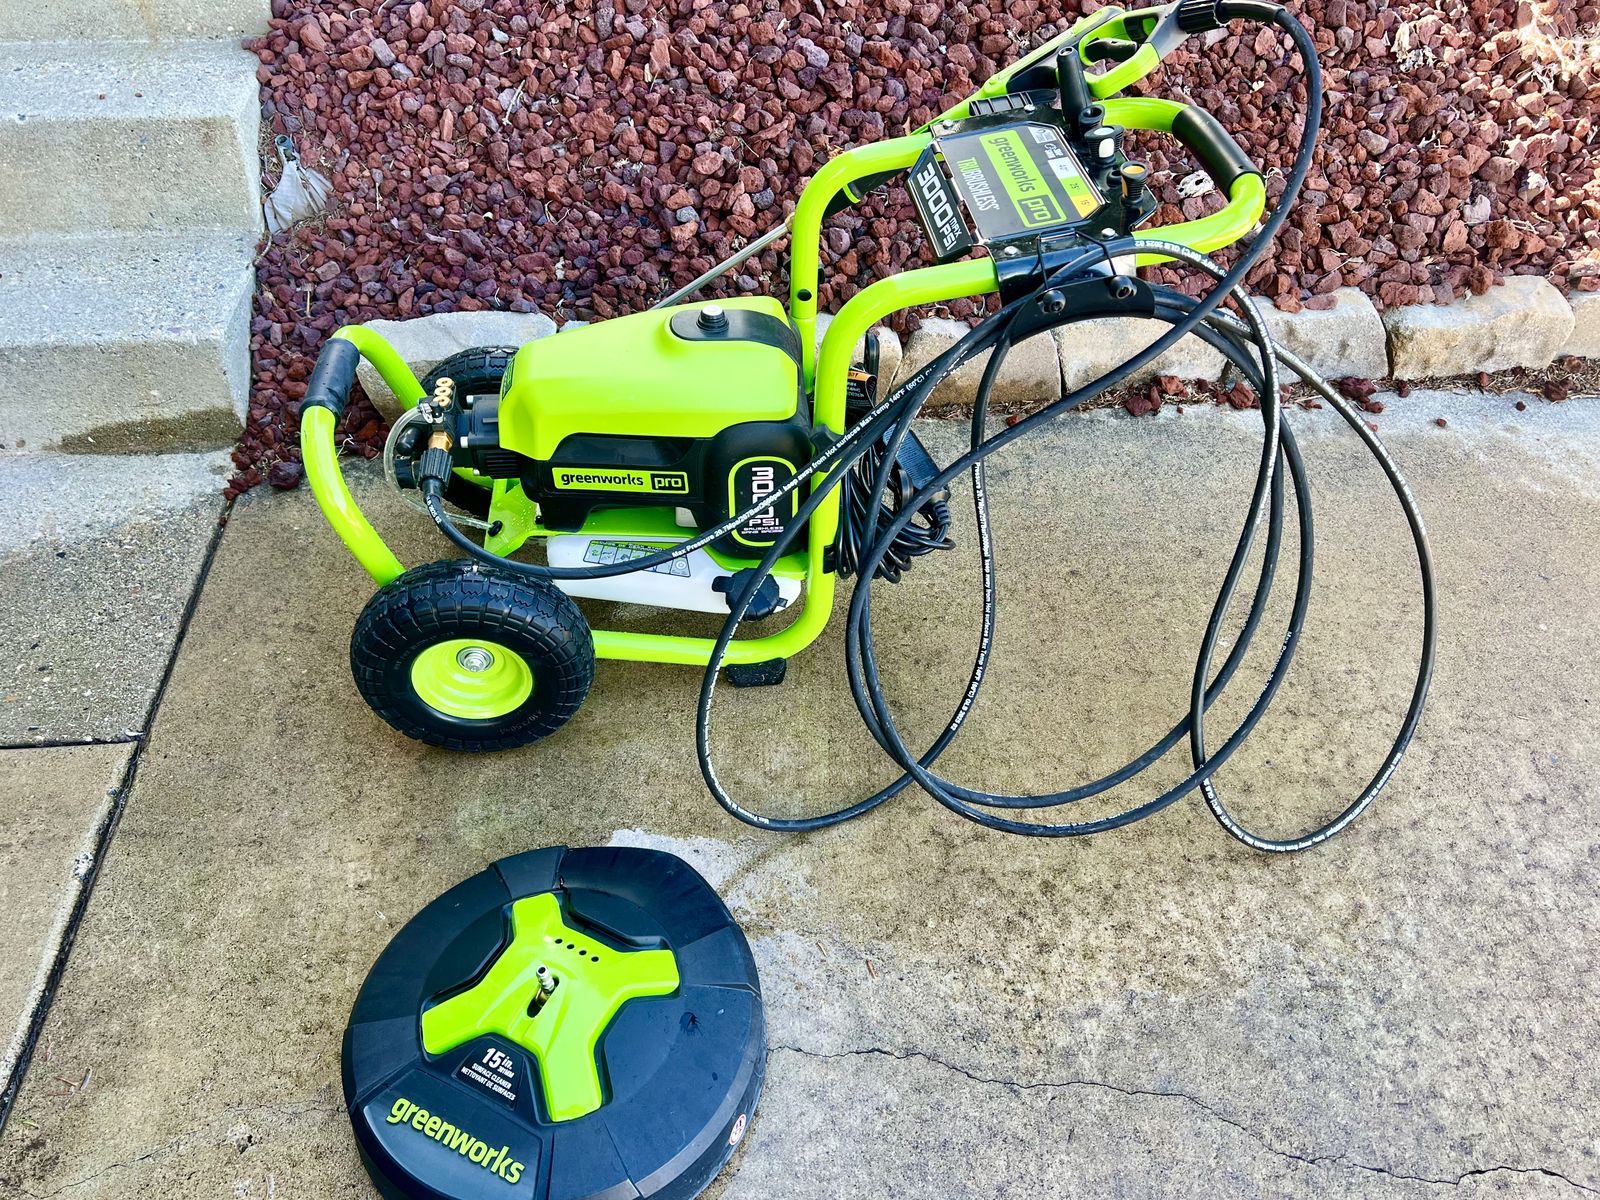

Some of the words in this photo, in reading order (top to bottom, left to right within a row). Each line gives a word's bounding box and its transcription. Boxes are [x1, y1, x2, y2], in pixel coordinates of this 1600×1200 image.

[988, 137, 1037, 193] greenworks
[1021, 196, 1051, 220] pro
[916, 161, 954, 228] 3000
[939, 222, 957, 251] PSI
[949, 216, 962, 238] MAX
[561, 473, 644, 486] greenworks
[654, 478, 682, 489] pro
[671, 549, 687, 558] Max
[686, 534, 714, 551] Pressure
[783, 478, 798, 492] keep
[798, 466, 813, 480] away
[812, 456, 827, 469] from
[825, 446, 838, 458] Hot
[837, 426, 861, 448] surfaces
[859, 416, 874, 428] Max
[872, 402, 890, 417] Temp
[748, 518, 779, 526] PSI
[983, 613, 991, 637] surfaces
[481, 1047, 506, 1069] 15
[501, 1056, 513, 1071] in.
[460, 1066, 486, 1085] NETTOYANT
[485, 1080, 493, 1089] DE
[491, 1083, 517, 1101] SURFACES
[471, 1063, 491, 1079] SURFACE
[490, 1073, 512, 1090] CLEANER
[386, 1097, 526, 1184] greenworks
